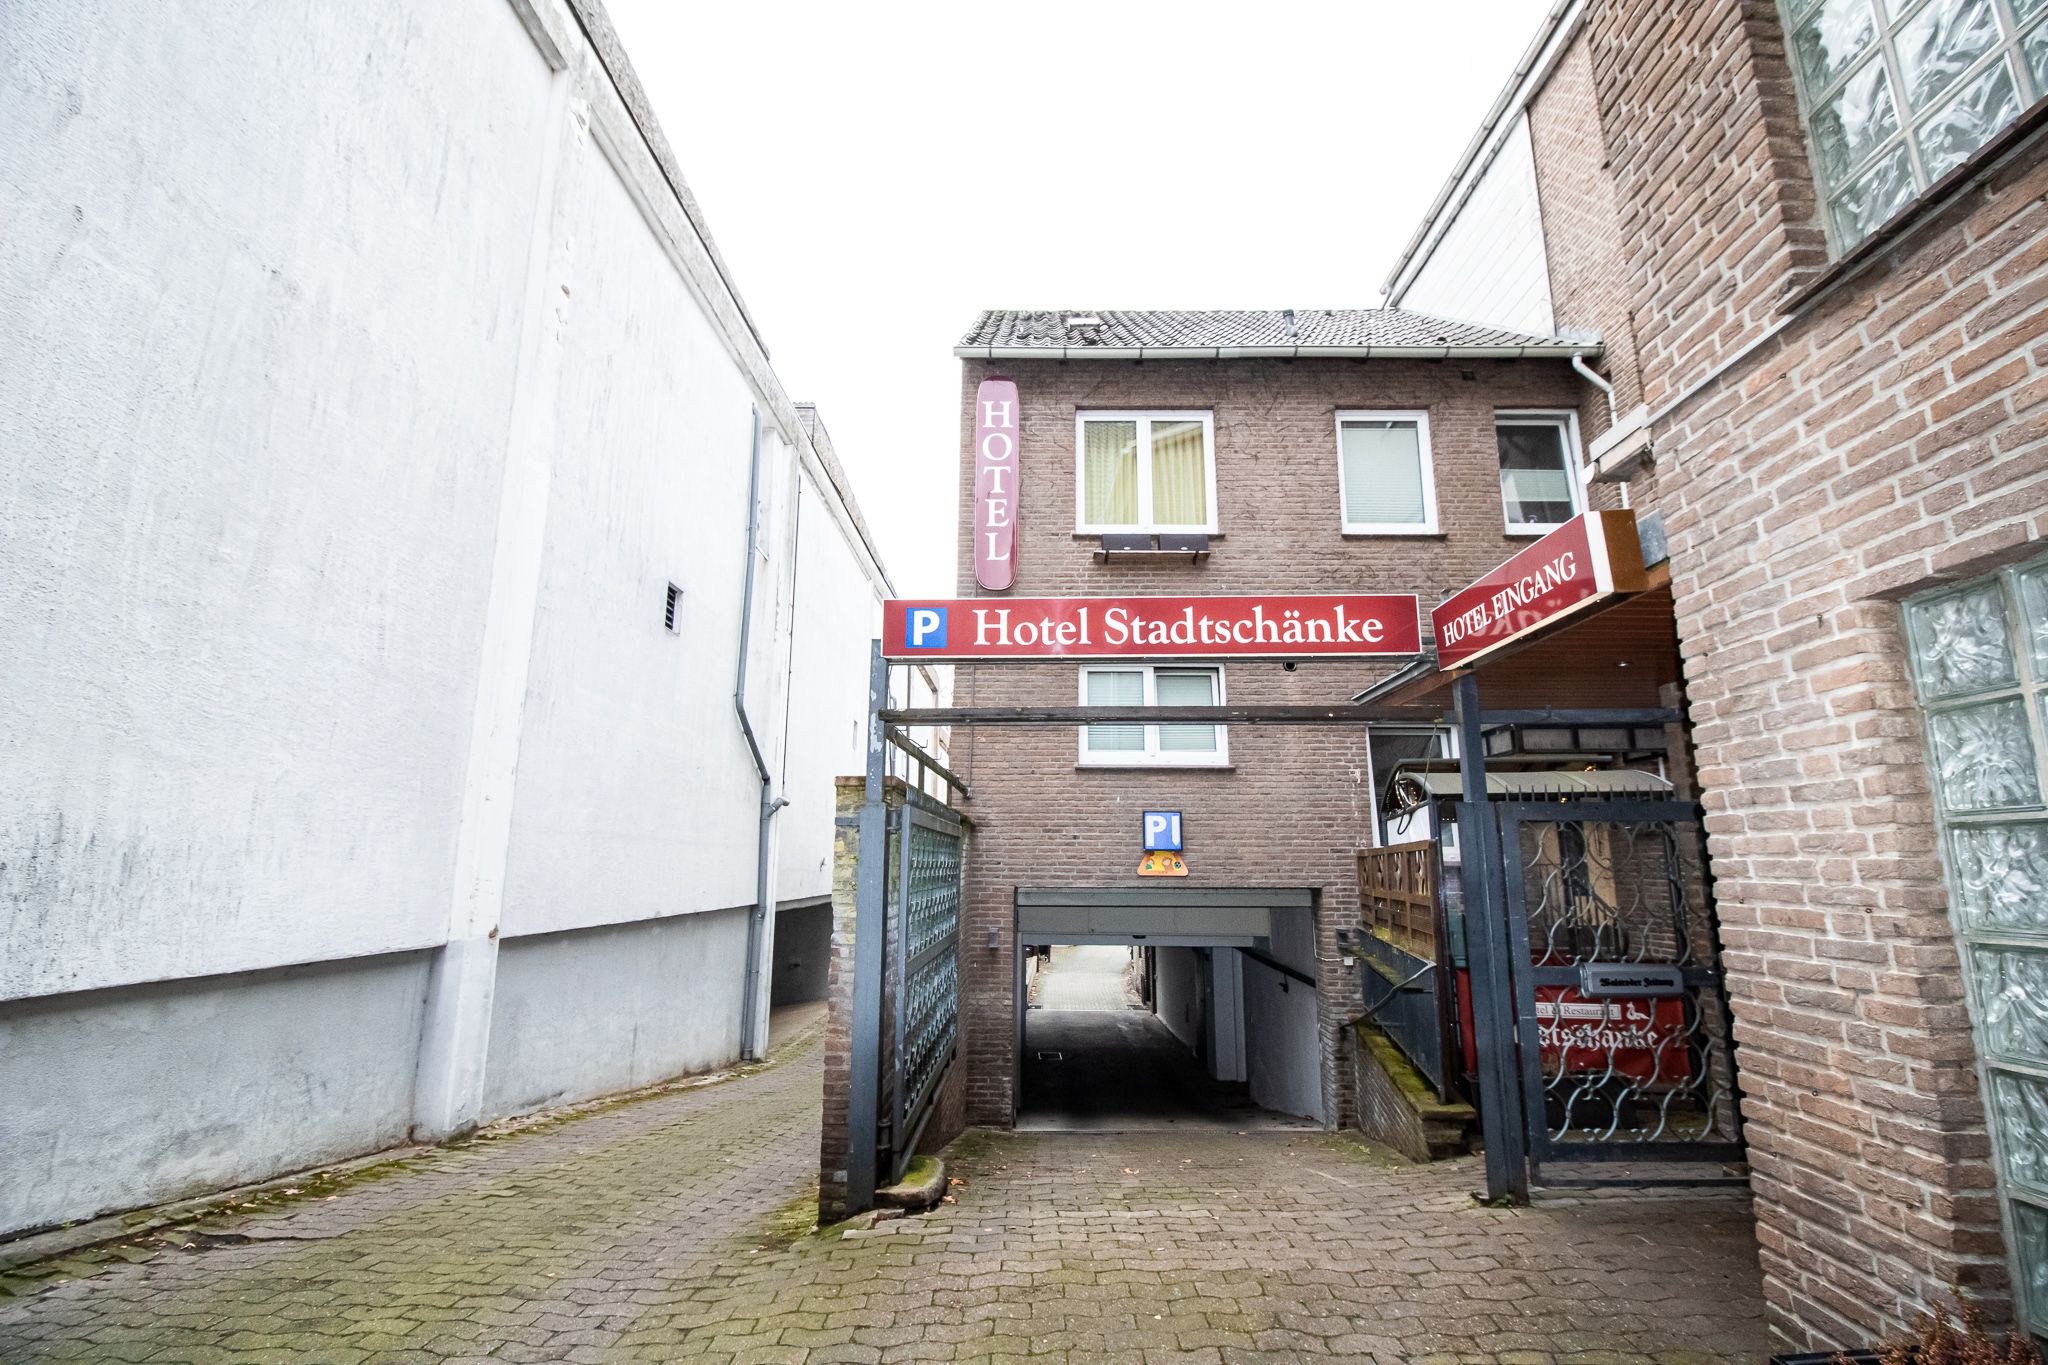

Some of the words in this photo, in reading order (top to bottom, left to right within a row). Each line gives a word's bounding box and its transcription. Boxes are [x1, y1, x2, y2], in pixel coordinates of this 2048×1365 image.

[982, 400, 1013, 561] HOTEL
[912, 610, 940, 647] P
[972, 608, 1090, 646] Hotel
[1103, 604, 1384, 646] Stadtschänke
[1442, 602, 1492, 647] HOTEL
[1490, 551, 1576, 619] EINGANG
